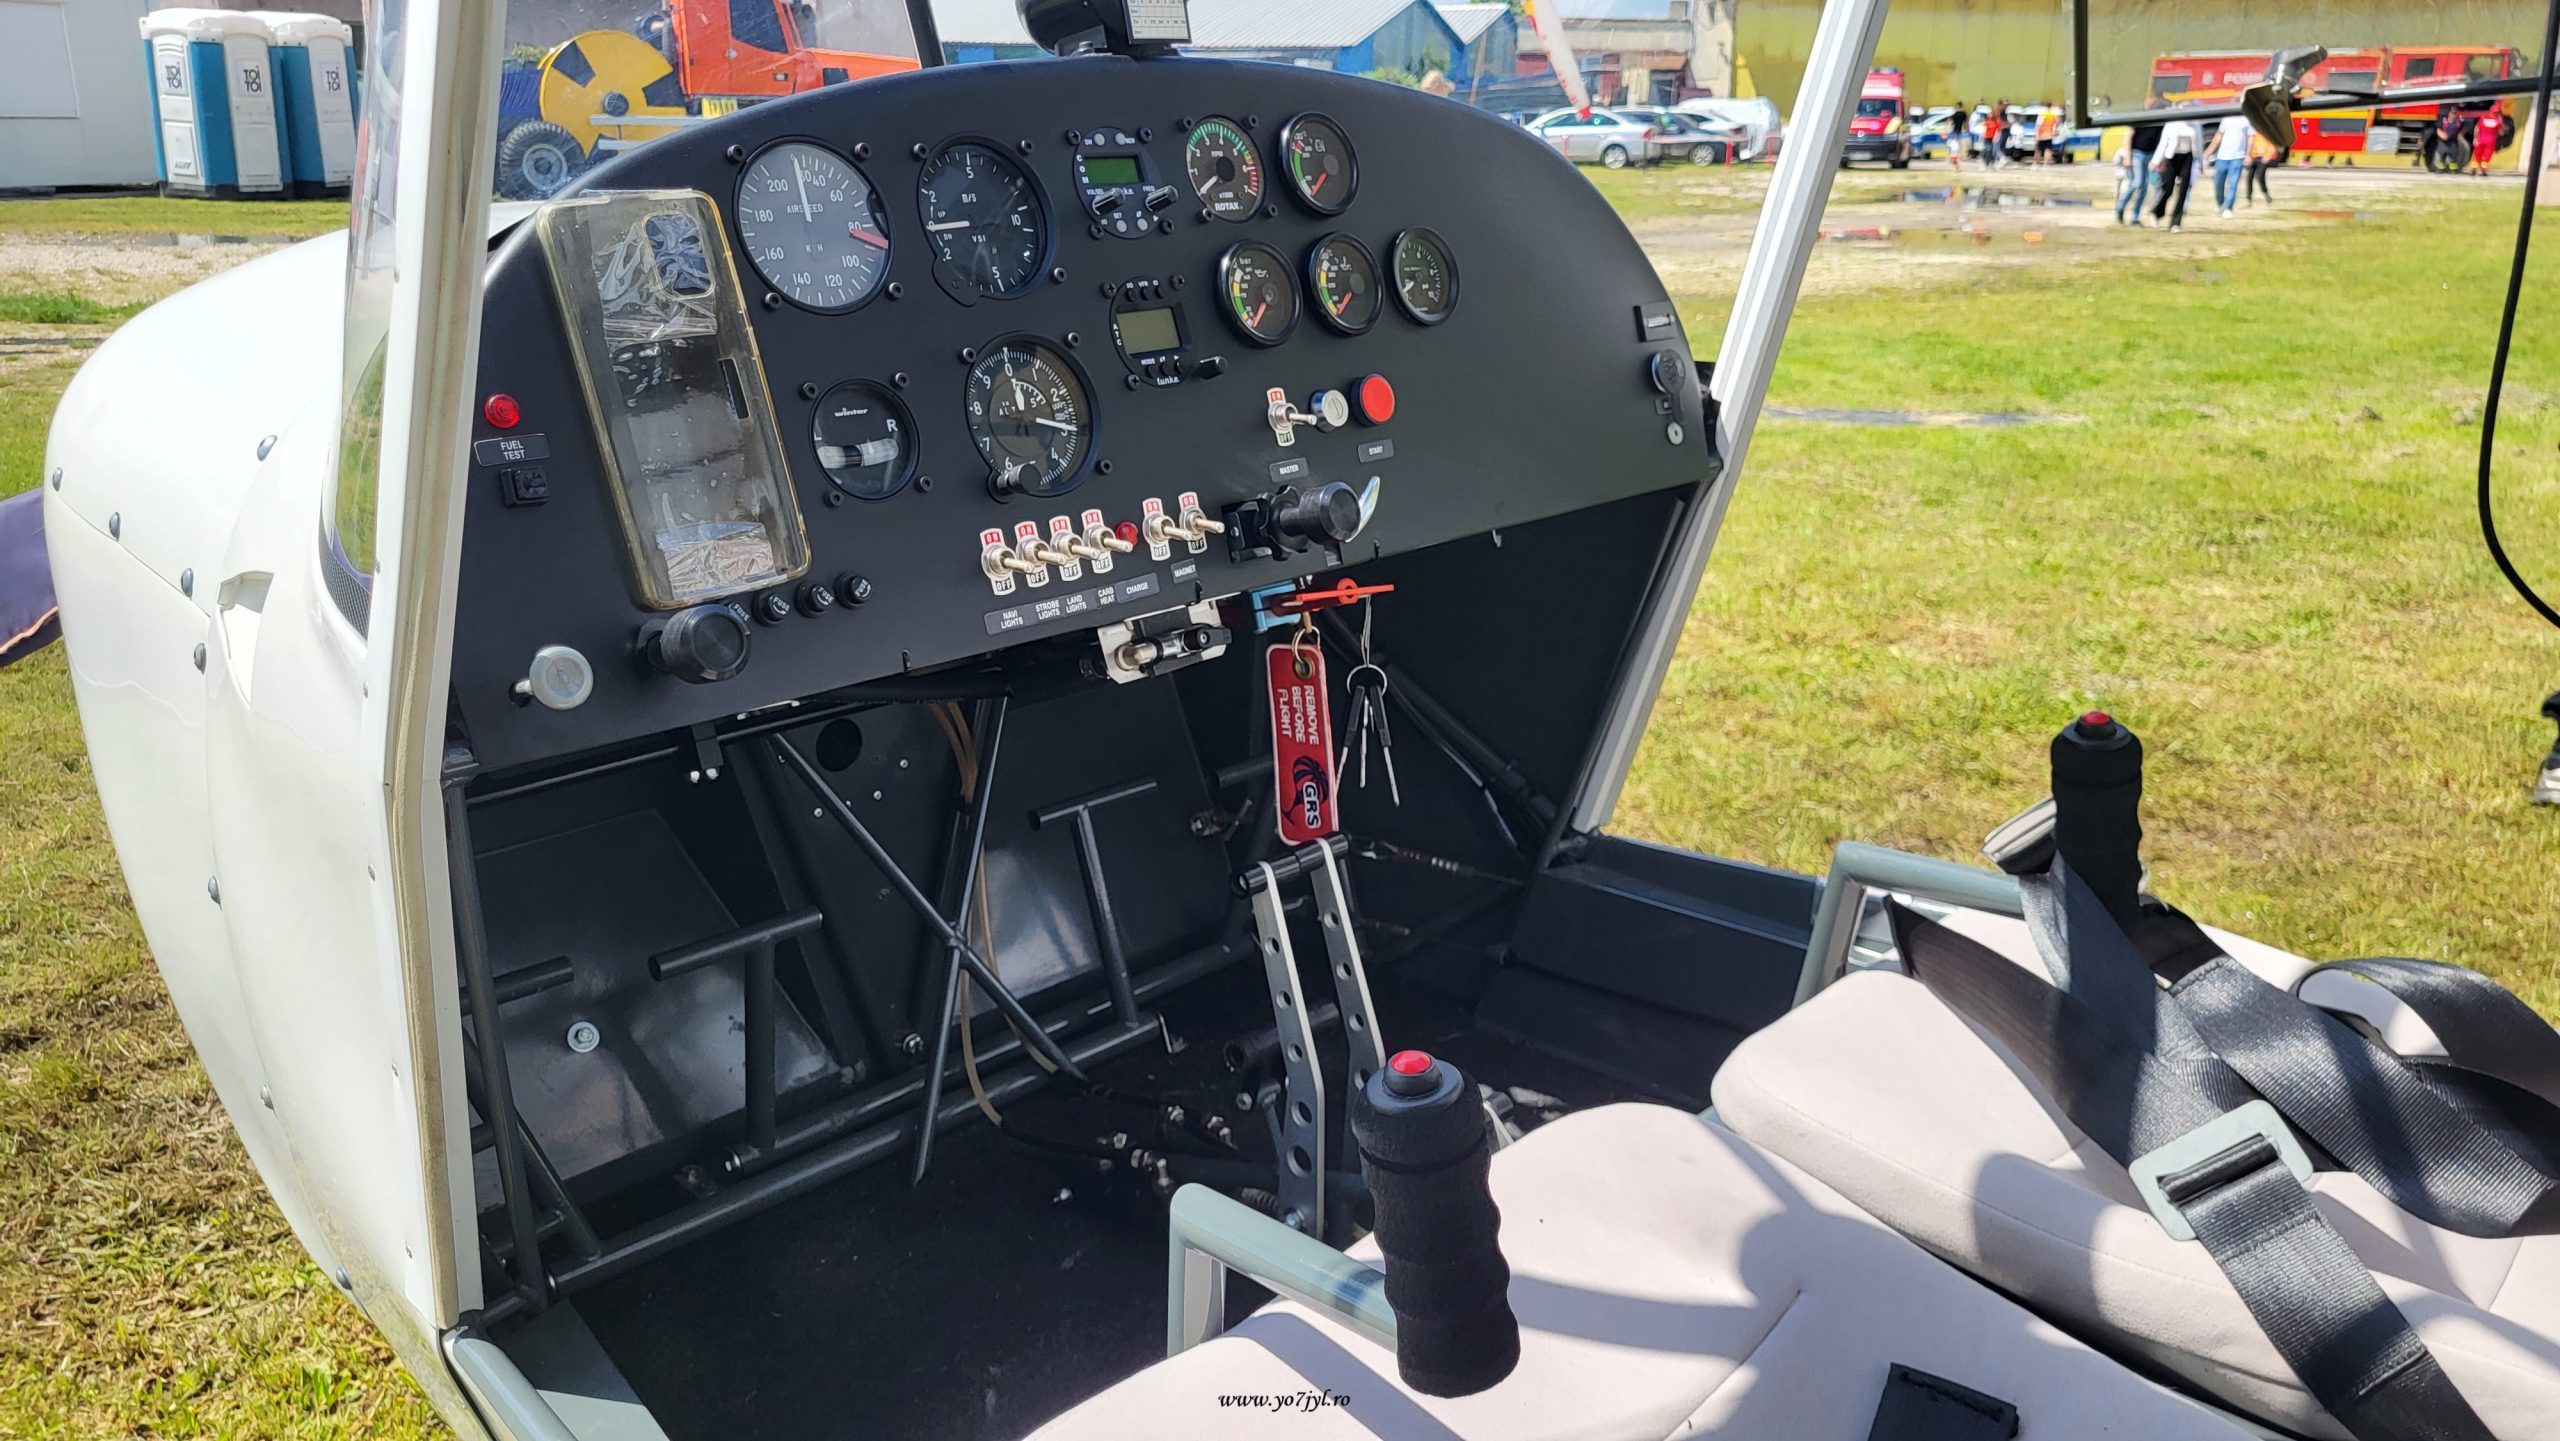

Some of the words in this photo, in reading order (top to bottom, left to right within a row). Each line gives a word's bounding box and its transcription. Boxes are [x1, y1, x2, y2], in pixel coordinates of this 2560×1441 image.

[167, 77, 182, 89] TOI
[245, 80, 262, 92] TOI
[327, 80, 341, 92] TOI
[1211, 150, 1224, 158] RPM
[966, 167, 974, 179] 5
[767, 179, 789, 192] 200
[812, 174, 826, 187] 40
[830, 189, 843, 202] 60
[928, 190, 937, 202] 2
[787, 203, 824, 214] AIRSEED
[1214, 202, 1240, 211] ROTAX
[754, 209, 774, 222] 180
[1010, 214, 1021, 226] 10
[848, 221, 862, 233] 80
[765, 247, 784, 260] 160
[841, 255, 860, 267] 100
[1239, 257, 1252, 265] bar
[991, 266, 1000, 278] 5
[792, 272, 812, 285] 140
[824, 274, 843, 287] 120
[1004, 363, 1013, 377] 0
[982, 376, 991, 389] 9
[1050, 388, 1060, 402] 2
[973, 401, 983, 415] 8
[1030, 398, 1037, 408] 5
[834, 407, 869, 417] winter
[886, 419, 898, 432] R
[500, 440, 524, 451] FUEL
[983, 437, 991, 452] 7
[503, 449, 526, 461] TEST
[1051, 447, 1059, 460] 4
[1004, 457, 1013, 470] 6
[1279, 463, 1299, 475] MASTER
[1147, 502, 1159, 512] ON
[1183, 496, 1195, 506] ON
[1087, 512, 1100, 523] ON
[1020, 526, 1033, 536] ON
[1053, 520, 1067, 531] ON
[985, 533, 1000, 543] ON
[1154, 546, 1168, 556] OFF
[1191, 540, 1205, 550] OFF
[1095, 559, 1110, 570] OFF
[1064, 566, 1078, 577] OFF
[1174, 564, 1197, 578] MAGNET
[1031, 572, 1046, 583] OFF
[855, 578, 870, 597] FUSE
[996, 580, 1012, 591] OFF
[1097, 586, 1115, 597] CARB
[1126, 582, 1150, 595] CHARGE
[818, 586, 835, 604] FUSE
[1066, 595, 1084, 605] LAND
[1100, 595, 1116, 605] HEAT
[773, 596, 791, 612] FUSE
[1035, 600, 1060, 612] STROBE
[1066, 602, 1087, 613] LIGHTS
[733, 603, 751, 622] FUSE
[1002, 610, 1018, 619] NAVI
[1038, 608, 1061, 620] LIGHTS
[1000, 617, 1024, 629] LIGHTS
[1277, 688, 1293, 739] FLIGHT
[1291, 685, 1306, 744] BEFORE
[1303, 685, 1320, 746] REMOVE
[1303, 782, 1321, 829] GRS
